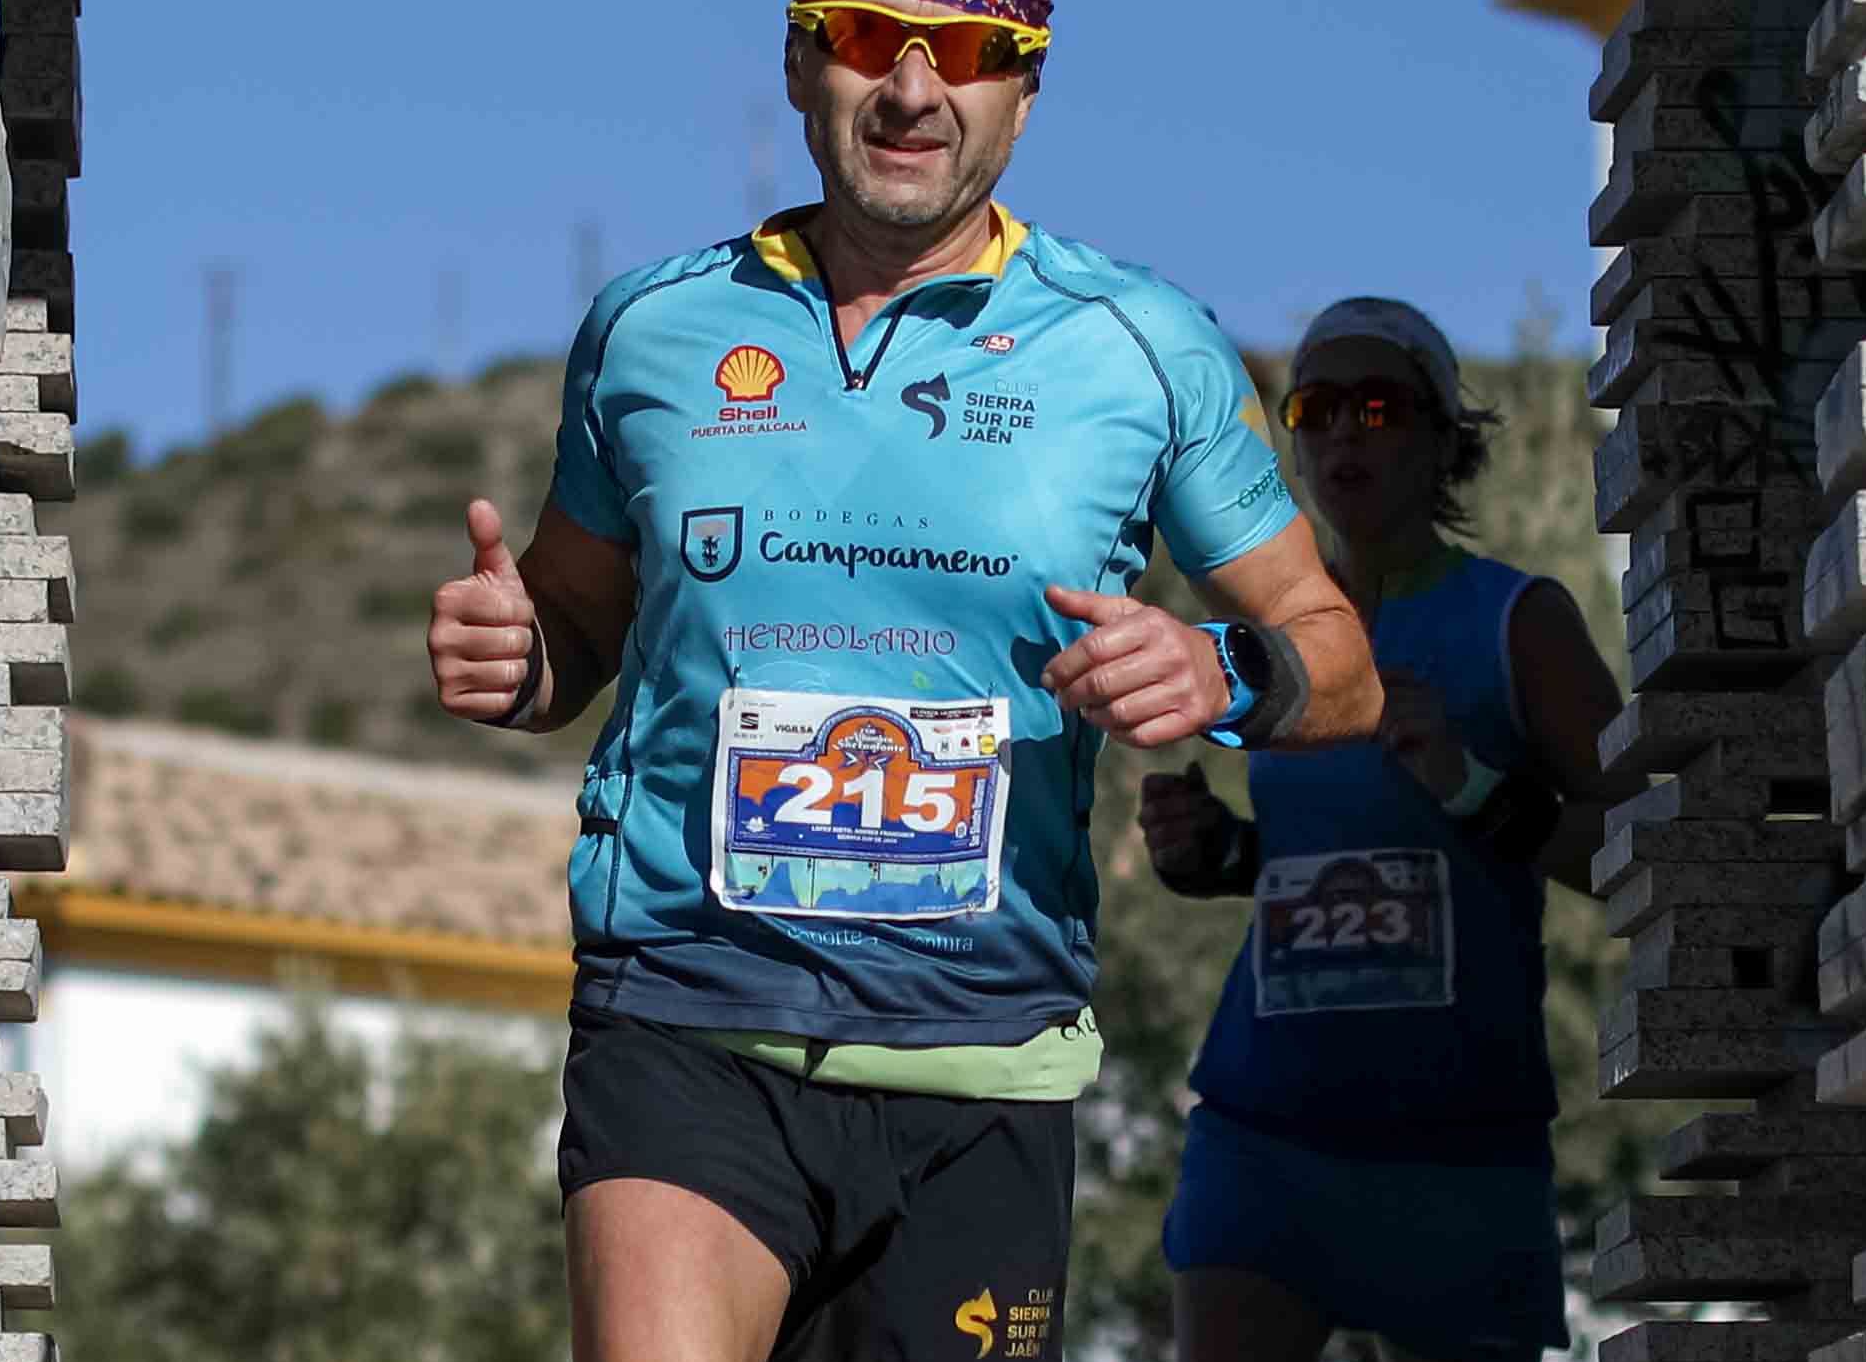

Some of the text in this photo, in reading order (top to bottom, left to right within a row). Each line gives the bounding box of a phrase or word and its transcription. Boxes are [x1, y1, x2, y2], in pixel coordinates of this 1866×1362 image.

[965, 391, 1036, 412] SIERRA
[718, 404, 778, 422] Shell
[962, 409, 1036, 430] SUR DE
[690, 420, 807, 439] PUERTA DE ALCALÁ
[763, 508, 931, 529] BODEGAS
[759, 531, 1012, 578] Campoameno
[724, 622, 957, 656] HERBOLARIO
[774, 763, 956, 833] 215
[1290, 900, 1411, 952] 223
